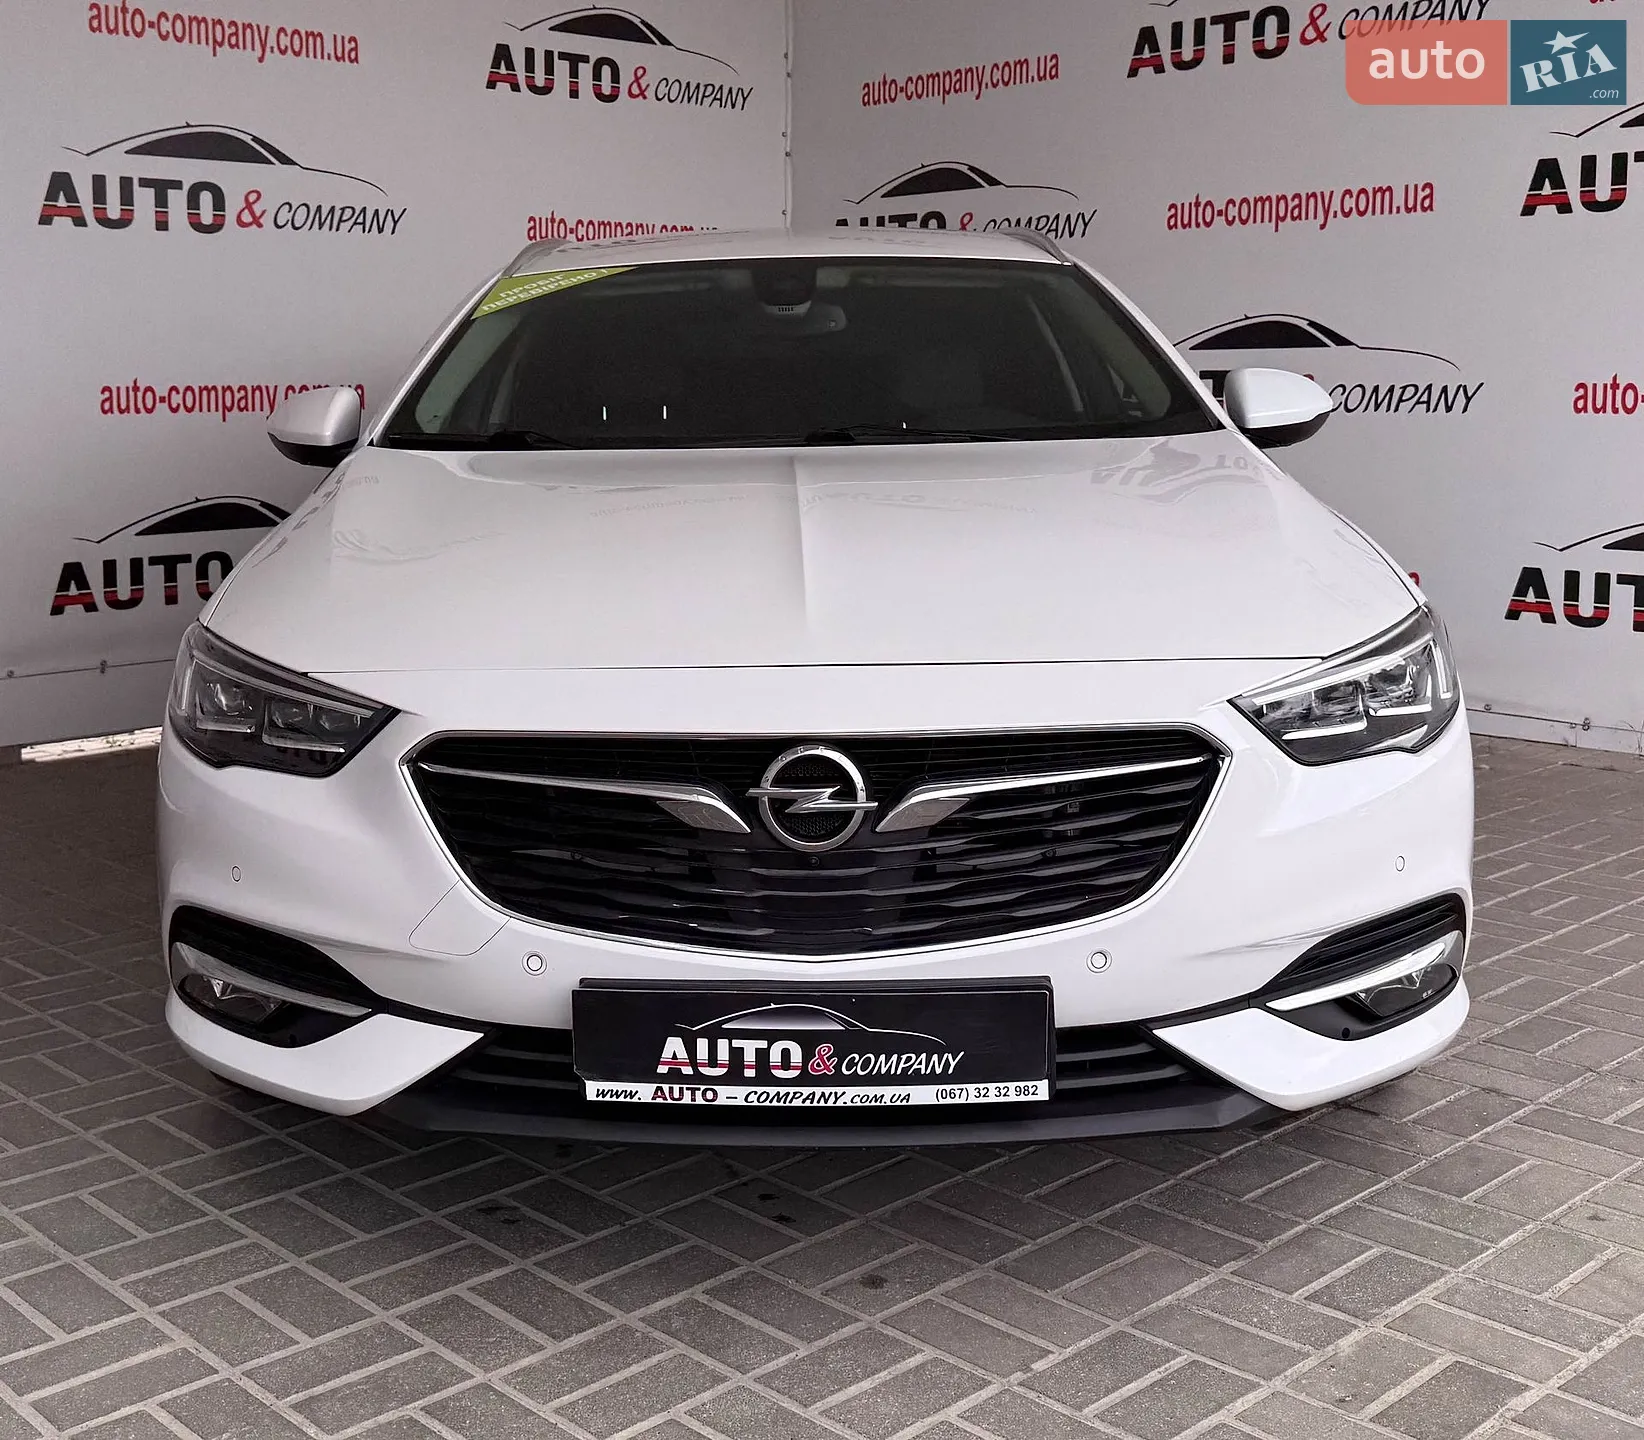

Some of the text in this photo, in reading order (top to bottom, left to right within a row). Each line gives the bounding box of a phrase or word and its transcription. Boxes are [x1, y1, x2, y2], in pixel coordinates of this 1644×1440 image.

[88, 0, 359, 64] auto-company.com.ua
[1127, 5, 1291, 78] AUTO
[1299, 3, 1332, 46] &
[486, 43, 753, 111] AUTO & COMPANY
[862, 53, 1060, 107] auto-company.com.ua
[38, 171, 407, 235] AUTO & COMPANY
[1166, 181, 1435, 232] auto-company.com.ua
[1329, 382, 1485, 415] COMPANY
[50, 551, 234, 616] AUTO
[656, 1036, 965, 1078] AUTO & COMPANY
[595, 1088, 642, 1101] www.
[651, 1086, 719, 1103] AUTO
[935, 1085, 1039, 1102] (067) 32 32 982
